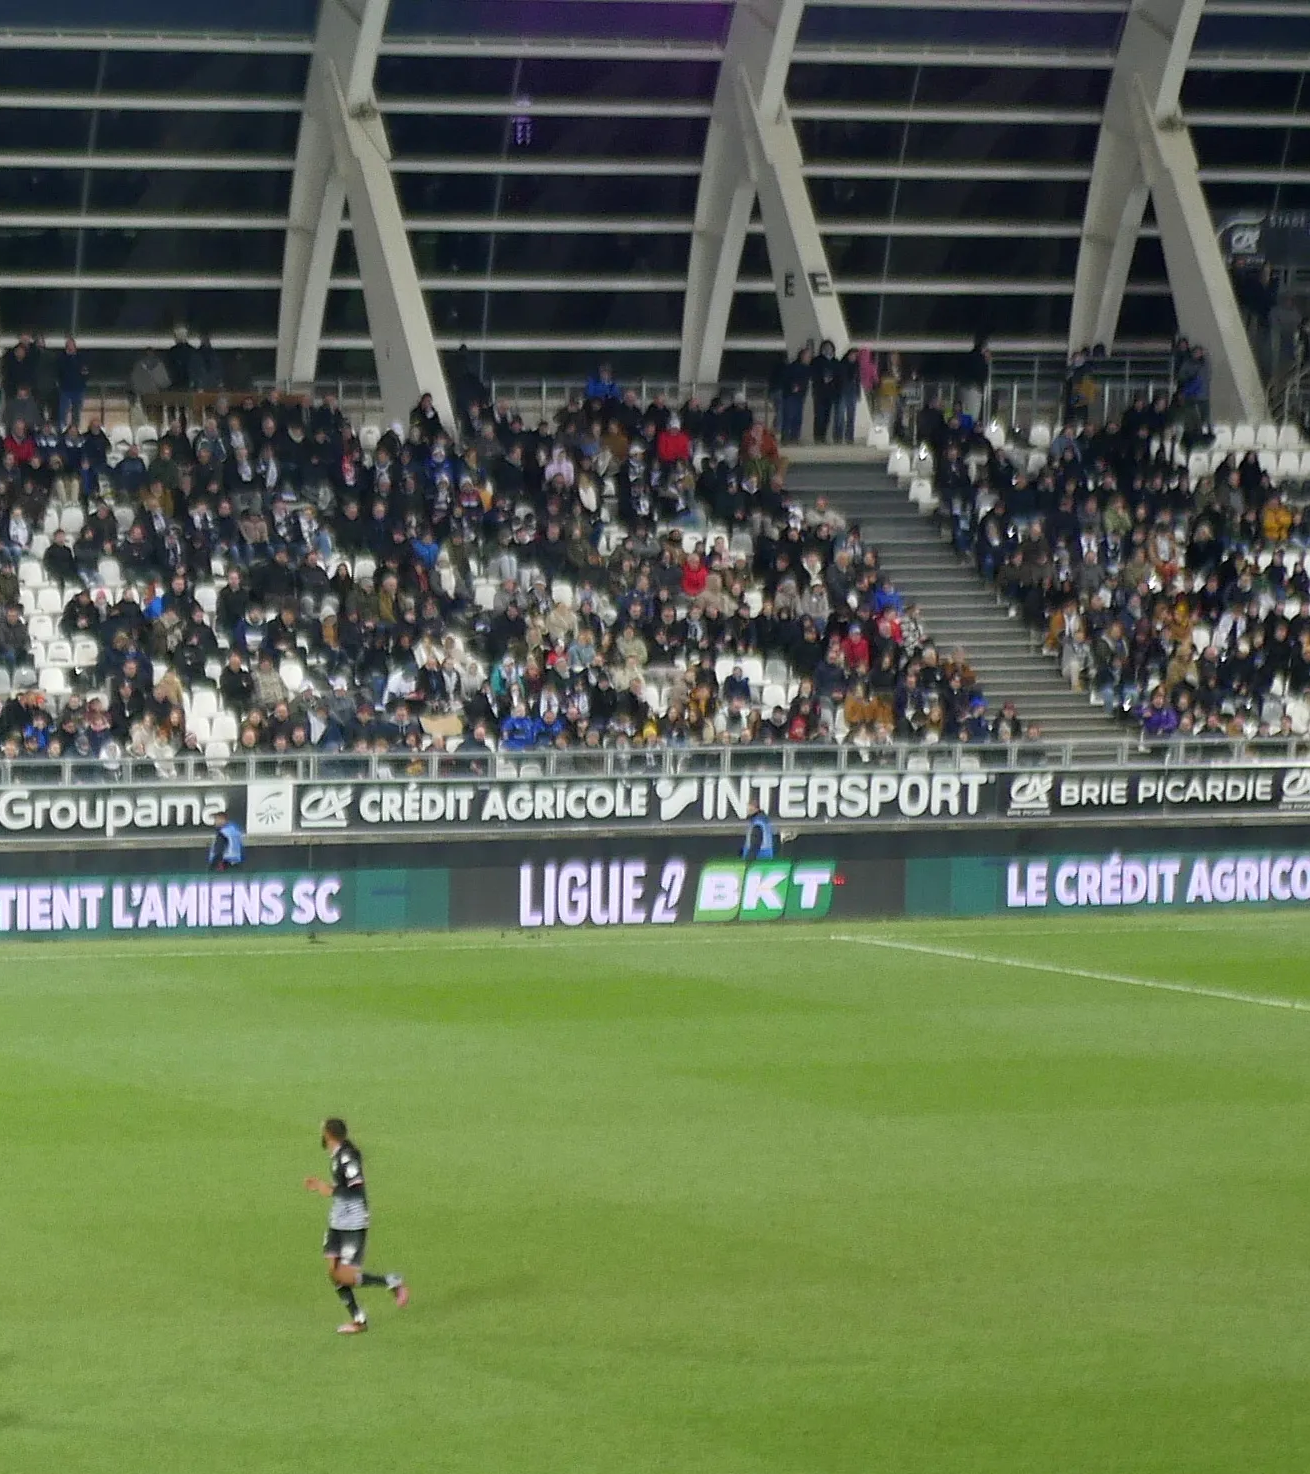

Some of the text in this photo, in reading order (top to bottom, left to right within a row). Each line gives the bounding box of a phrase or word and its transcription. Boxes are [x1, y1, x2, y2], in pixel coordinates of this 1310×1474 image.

[808, 271, 833, 297] E
[359, 783, 649, 823] CRÉDIT AGRICOLE
[702, 774, 987, 821] INTERSPORT
[1060, 772, 1274, 807] BRIE PICARDIE
[519, 858, 831, 926] LIGUE 2 BKT
[1006, 848, 1310, 907] LE CRÉDIT AGRICO
[112, 878, 284, 930] L'AMIENS
[291, 877, 342, 925] SC
